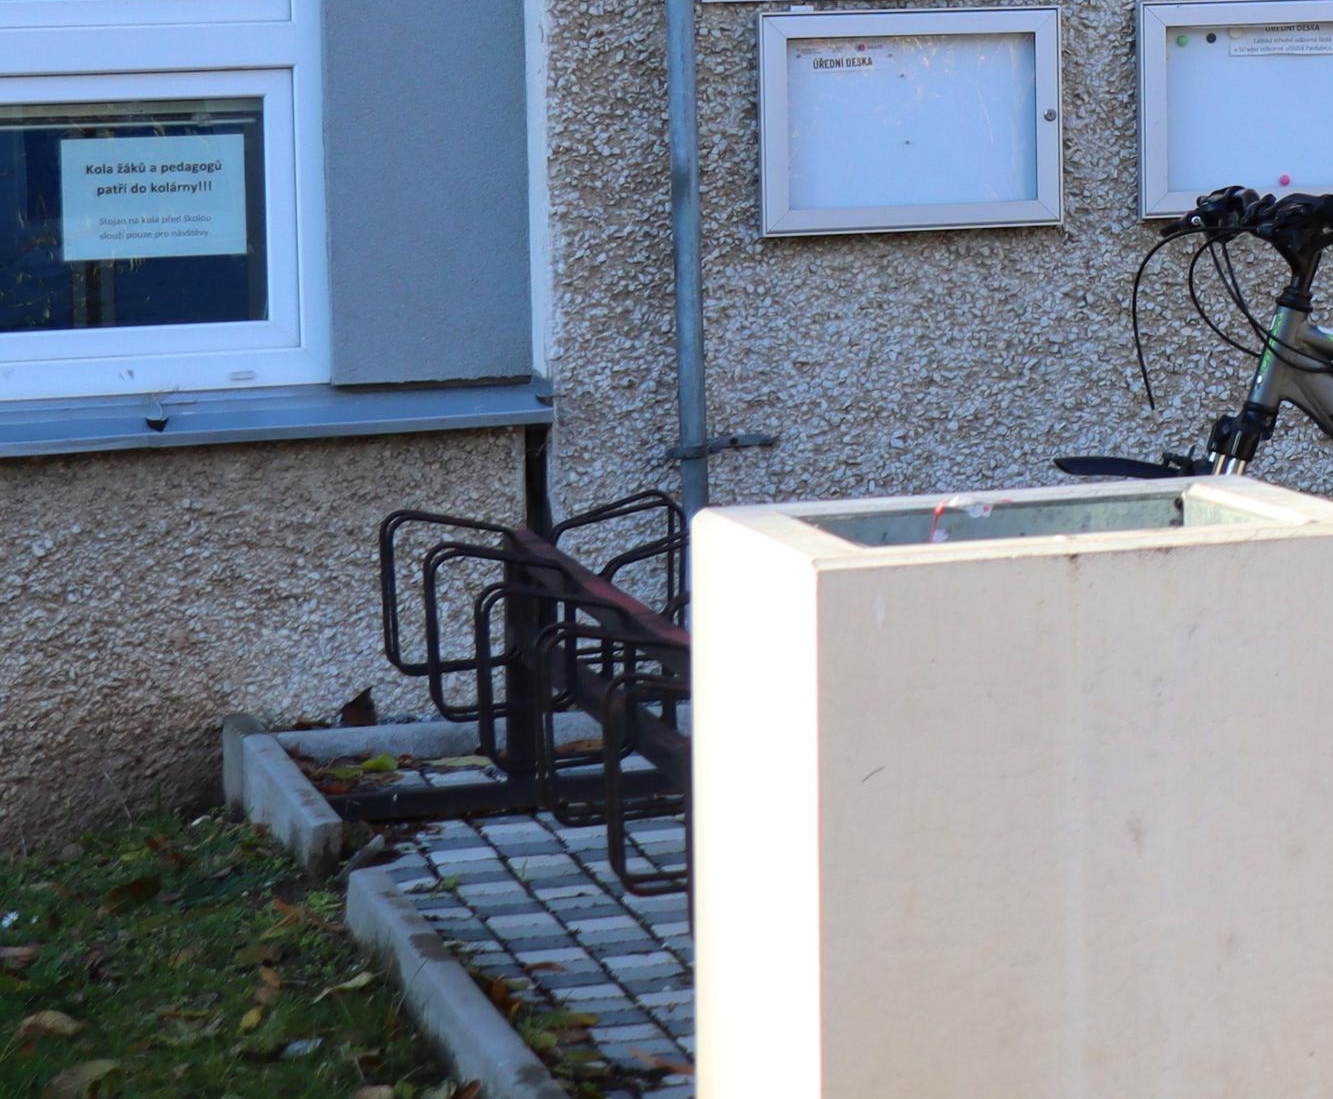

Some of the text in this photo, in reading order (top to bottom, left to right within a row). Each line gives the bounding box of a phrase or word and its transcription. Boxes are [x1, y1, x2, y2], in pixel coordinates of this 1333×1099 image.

[812, 56, 873, 70] ÚŘEDNÍ DESKA
[86, 159, 222, 175] Kola žáků a pedagogů
[96, 180, 213, 197] patří do kolárny!!!
